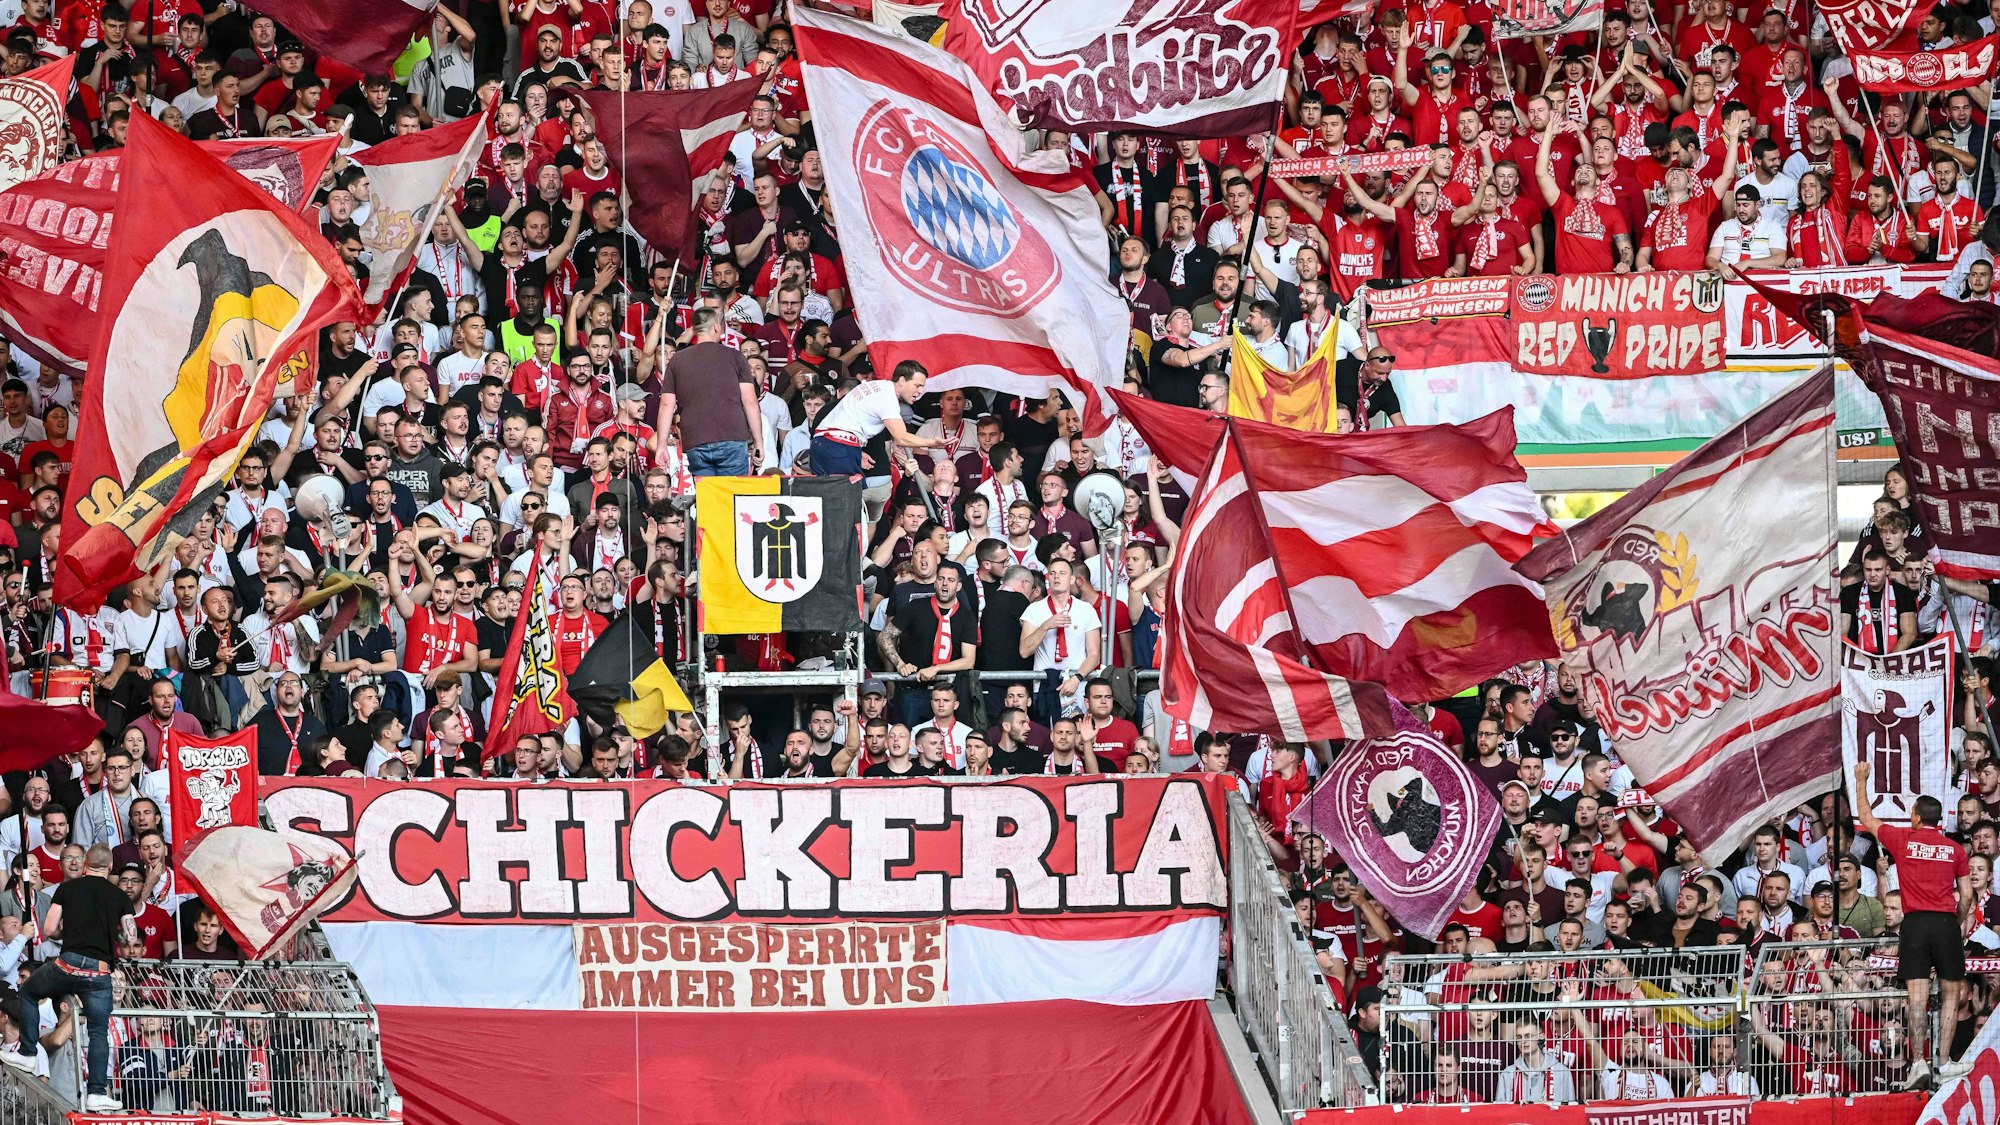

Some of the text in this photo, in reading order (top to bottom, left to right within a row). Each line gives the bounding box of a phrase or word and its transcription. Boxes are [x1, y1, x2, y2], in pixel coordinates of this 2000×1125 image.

[1272, 160, 1321, 172] MUNICH
[1363, 154, 1388, 166] RED
[1394, 150, 1431, 164] PRIDE
[903, 242, 1028, 307] ULTRAS
[1843, 276, 1892, 295] REBEL
[1370, 278, 1507, 302] NIEMALS ABWESEND
[1561, 274, 1692, 313] MUNICH'S
[1370, 300, 1504, 322] IMMER ANWESEND
[1518, 320, 1720, 370] RED PRIDE
[1839, 432, 1877, 448] USP
[387, 470, 428, 480] SUPER
[180, 746, 250, 770] TORCIDA
[263, 782, 1228, 921] SCHICKERIA
[579, 924, 942, 966] AUSGESPERRTE
[582, 964, 936, 1008] IMMER BEI UNS
